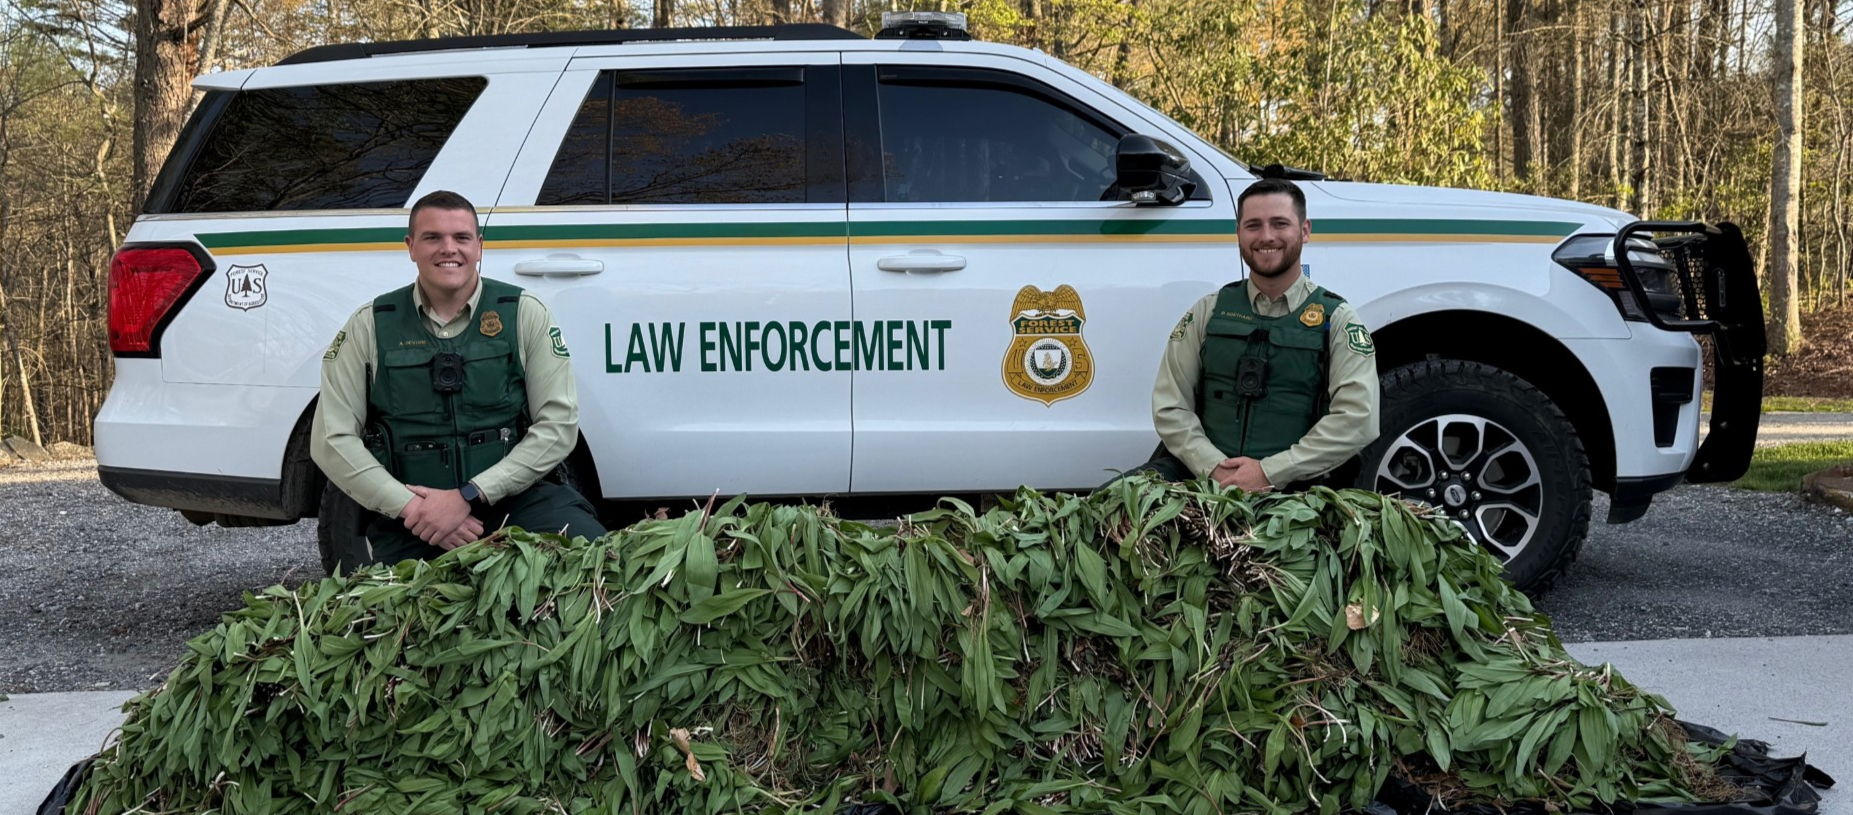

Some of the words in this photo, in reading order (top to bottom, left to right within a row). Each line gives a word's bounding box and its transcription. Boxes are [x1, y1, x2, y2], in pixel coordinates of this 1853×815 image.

[1020, 319, 1075, 327] FOREST
[1018, 326, 1077, 334] SERVICE
[604, 322, 685, 373] LAW
[699, 320, 952, 372] ENFORCEMENT
[1017, 379, 1033, 392] LAW
[1034, 380, 1078, 393] ENFORCEMENT
